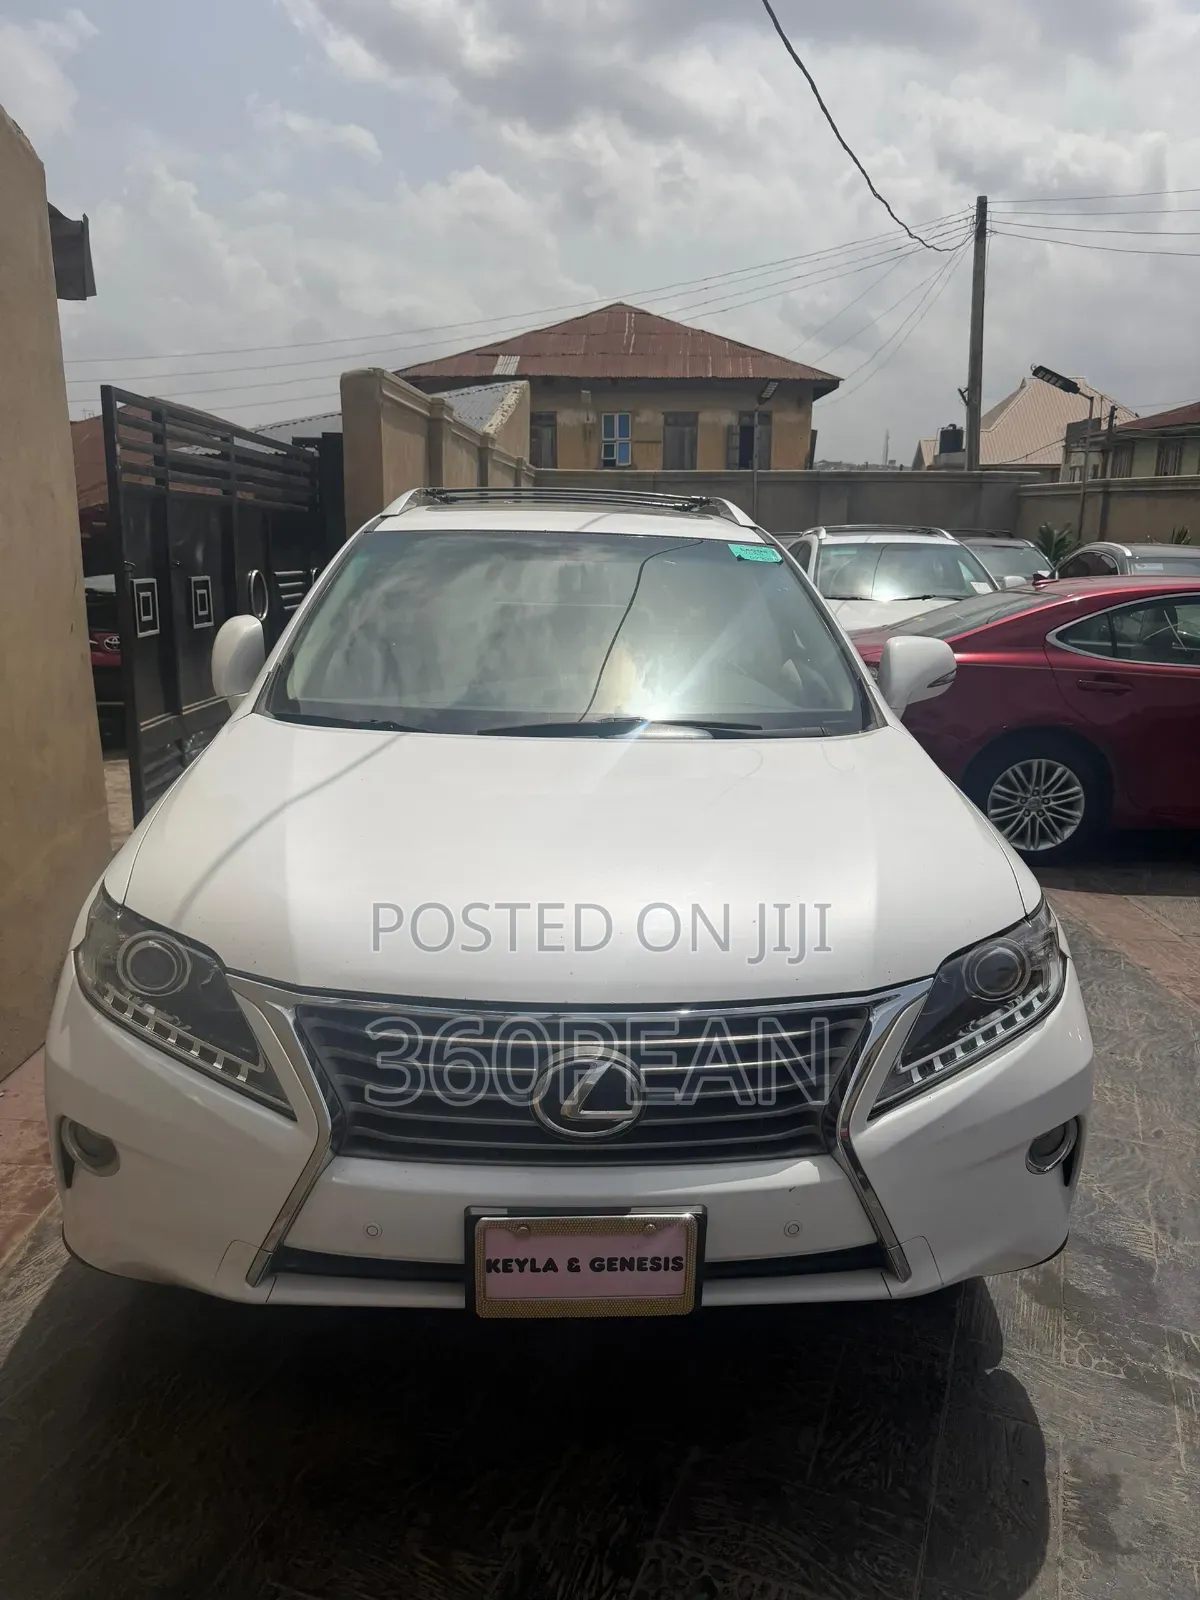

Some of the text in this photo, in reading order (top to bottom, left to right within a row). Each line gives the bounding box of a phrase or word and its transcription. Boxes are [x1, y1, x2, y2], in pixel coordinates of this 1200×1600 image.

[486, 1256, 684, 1274] KEYLA & GENESIS
